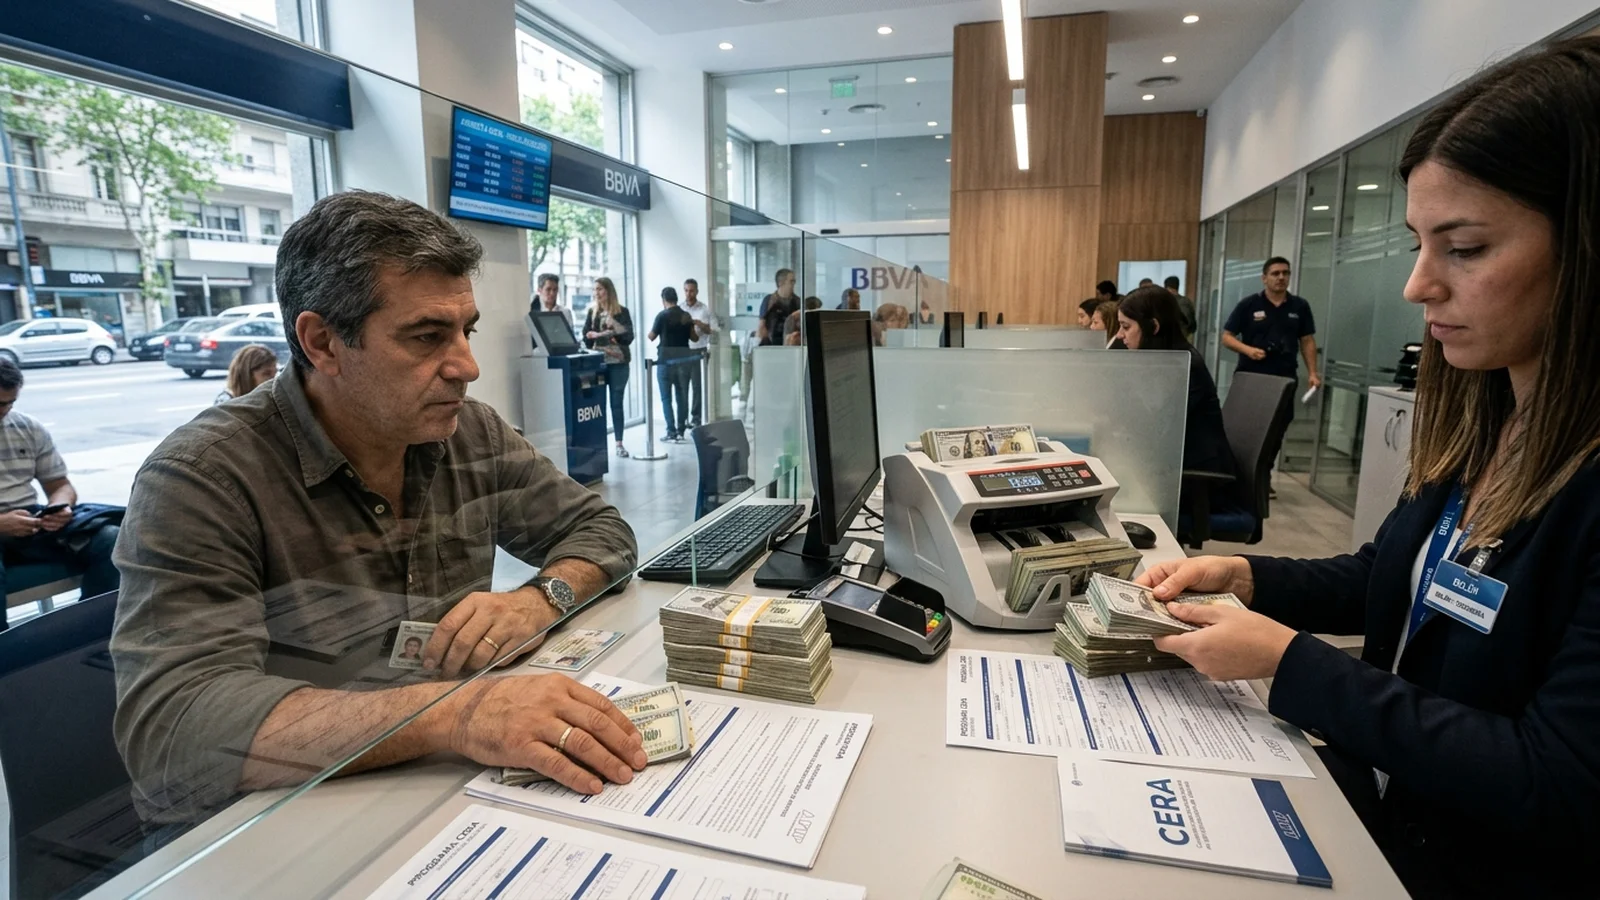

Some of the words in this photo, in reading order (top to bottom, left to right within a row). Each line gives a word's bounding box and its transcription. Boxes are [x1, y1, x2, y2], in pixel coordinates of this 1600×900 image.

[604, 168, 641, 197] BBVA
[851, 266, 929, 291] BBVA
[577, 404, 603, 423] BBVA
[1146, 777, 1190, 846] CERA
